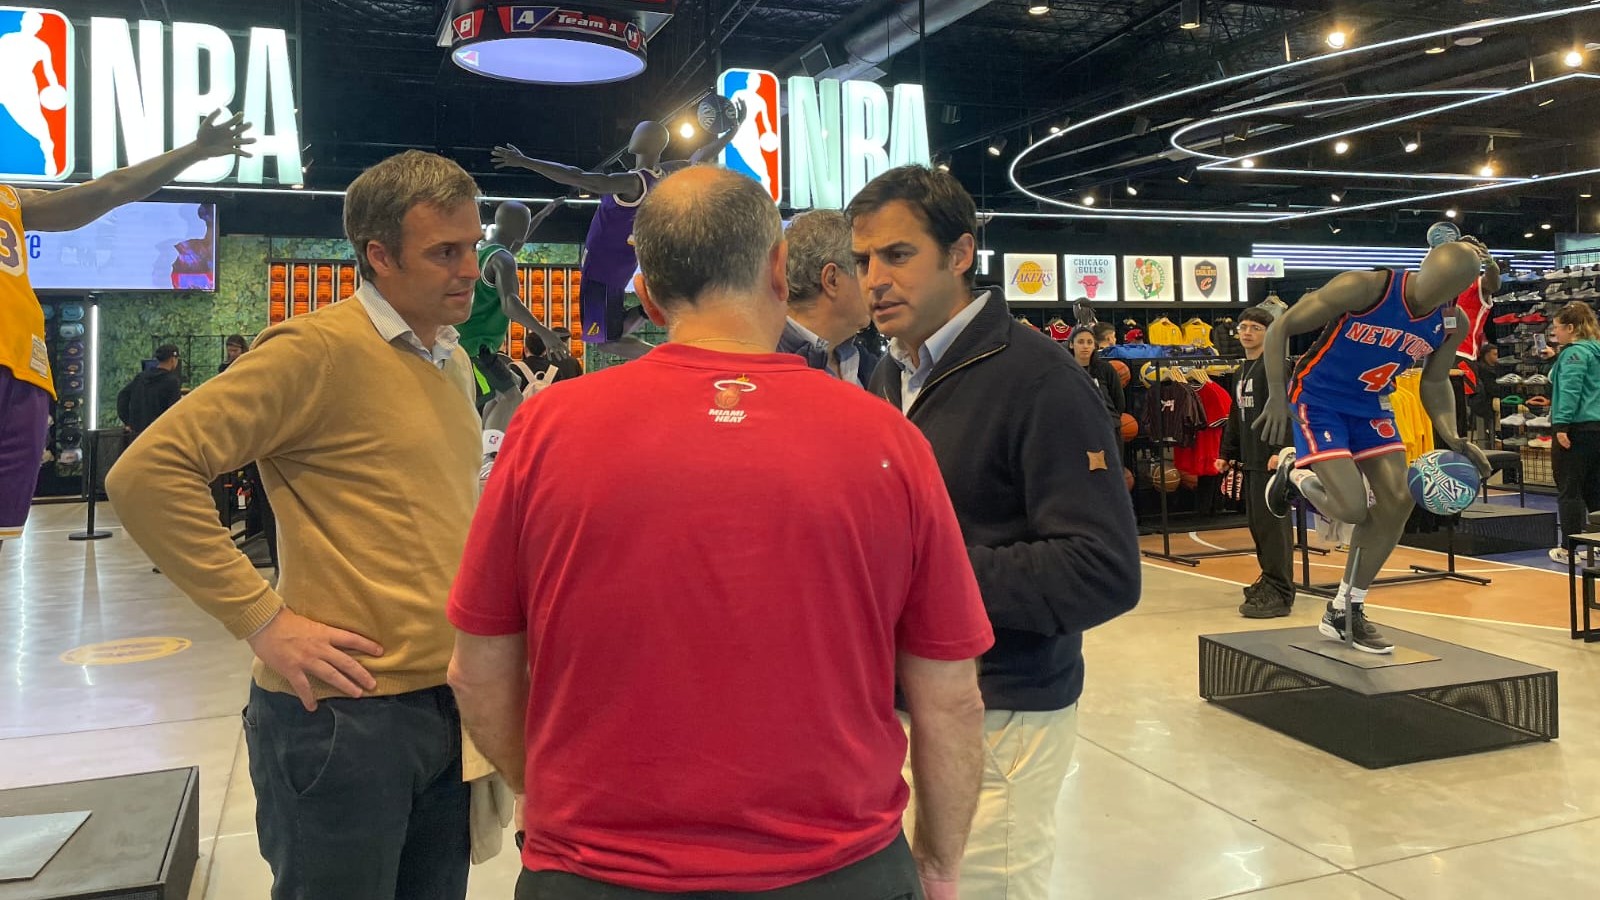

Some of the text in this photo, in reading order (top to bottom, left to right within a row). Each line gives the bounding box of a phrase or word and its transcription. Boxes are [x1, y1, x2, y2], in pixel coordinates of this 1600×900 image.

[516, 10, 534, 24] A
[558, 14, 617, 32] Team A
[91, 16, 304, 184] NBA
[787, 76, 930, 209] NBA
[1074, 259, 1109, 267] CHICAGO
[1009, 268, 1054, 286] LAKERS
[1345, 322, 1434, 360] NEW YOR
[1358, 362, 1400, 392] 4
[714, 415, 748, 423] HEAT
